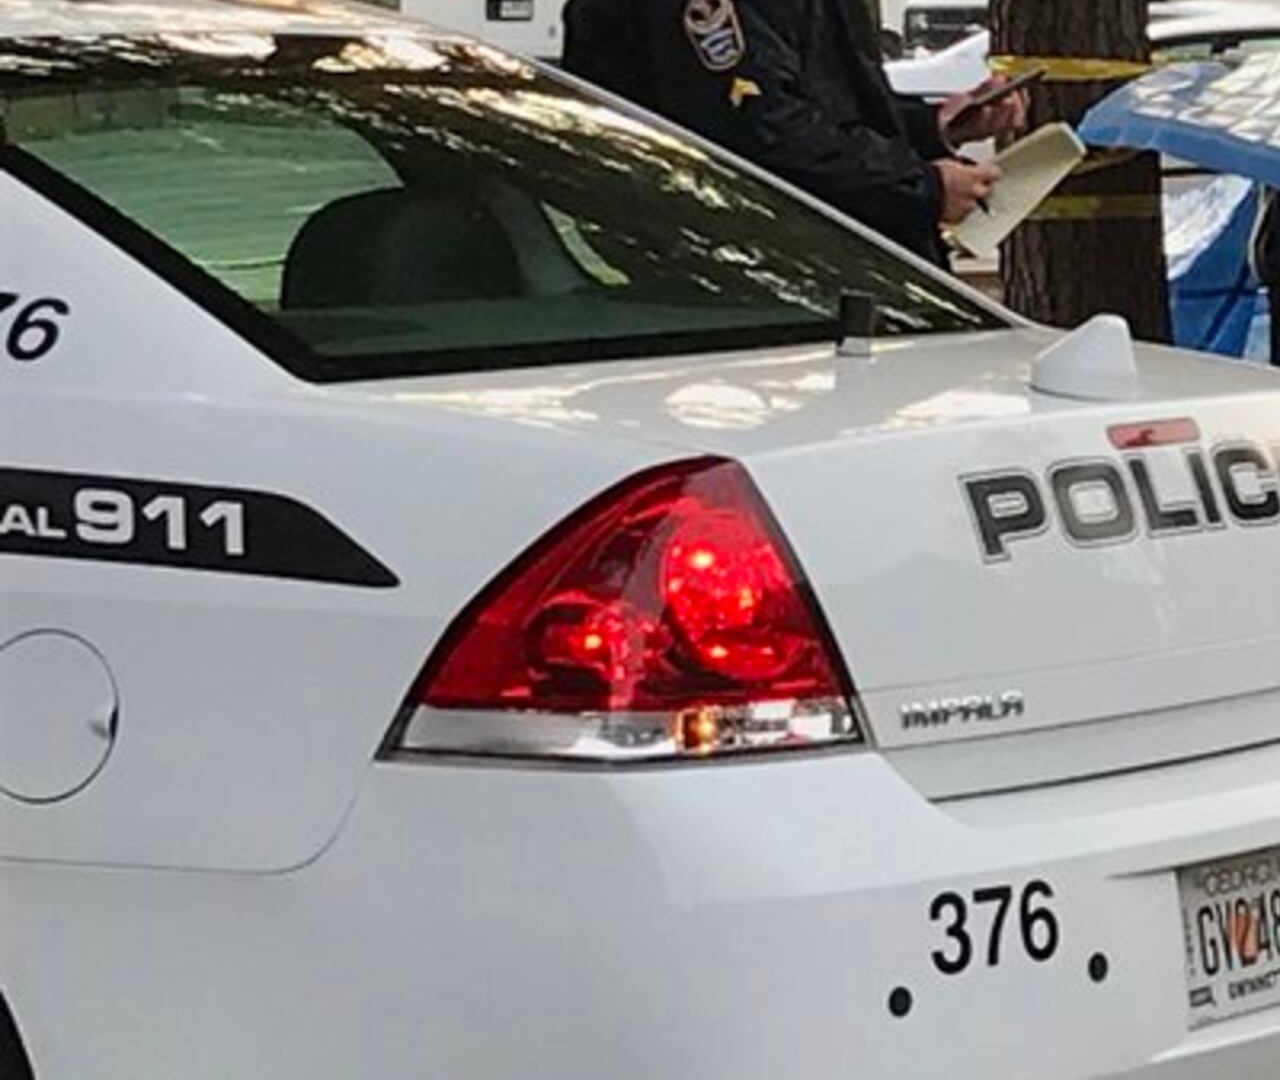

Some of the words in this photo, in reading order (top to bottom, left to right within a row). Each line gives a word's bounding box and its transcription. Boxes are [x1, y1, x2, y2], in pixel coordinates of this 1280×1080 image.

[73, 486, 245, 556] 911
[901, 689, 1024, 730] IMPALA
[929, 878, 1060, 976] 376
